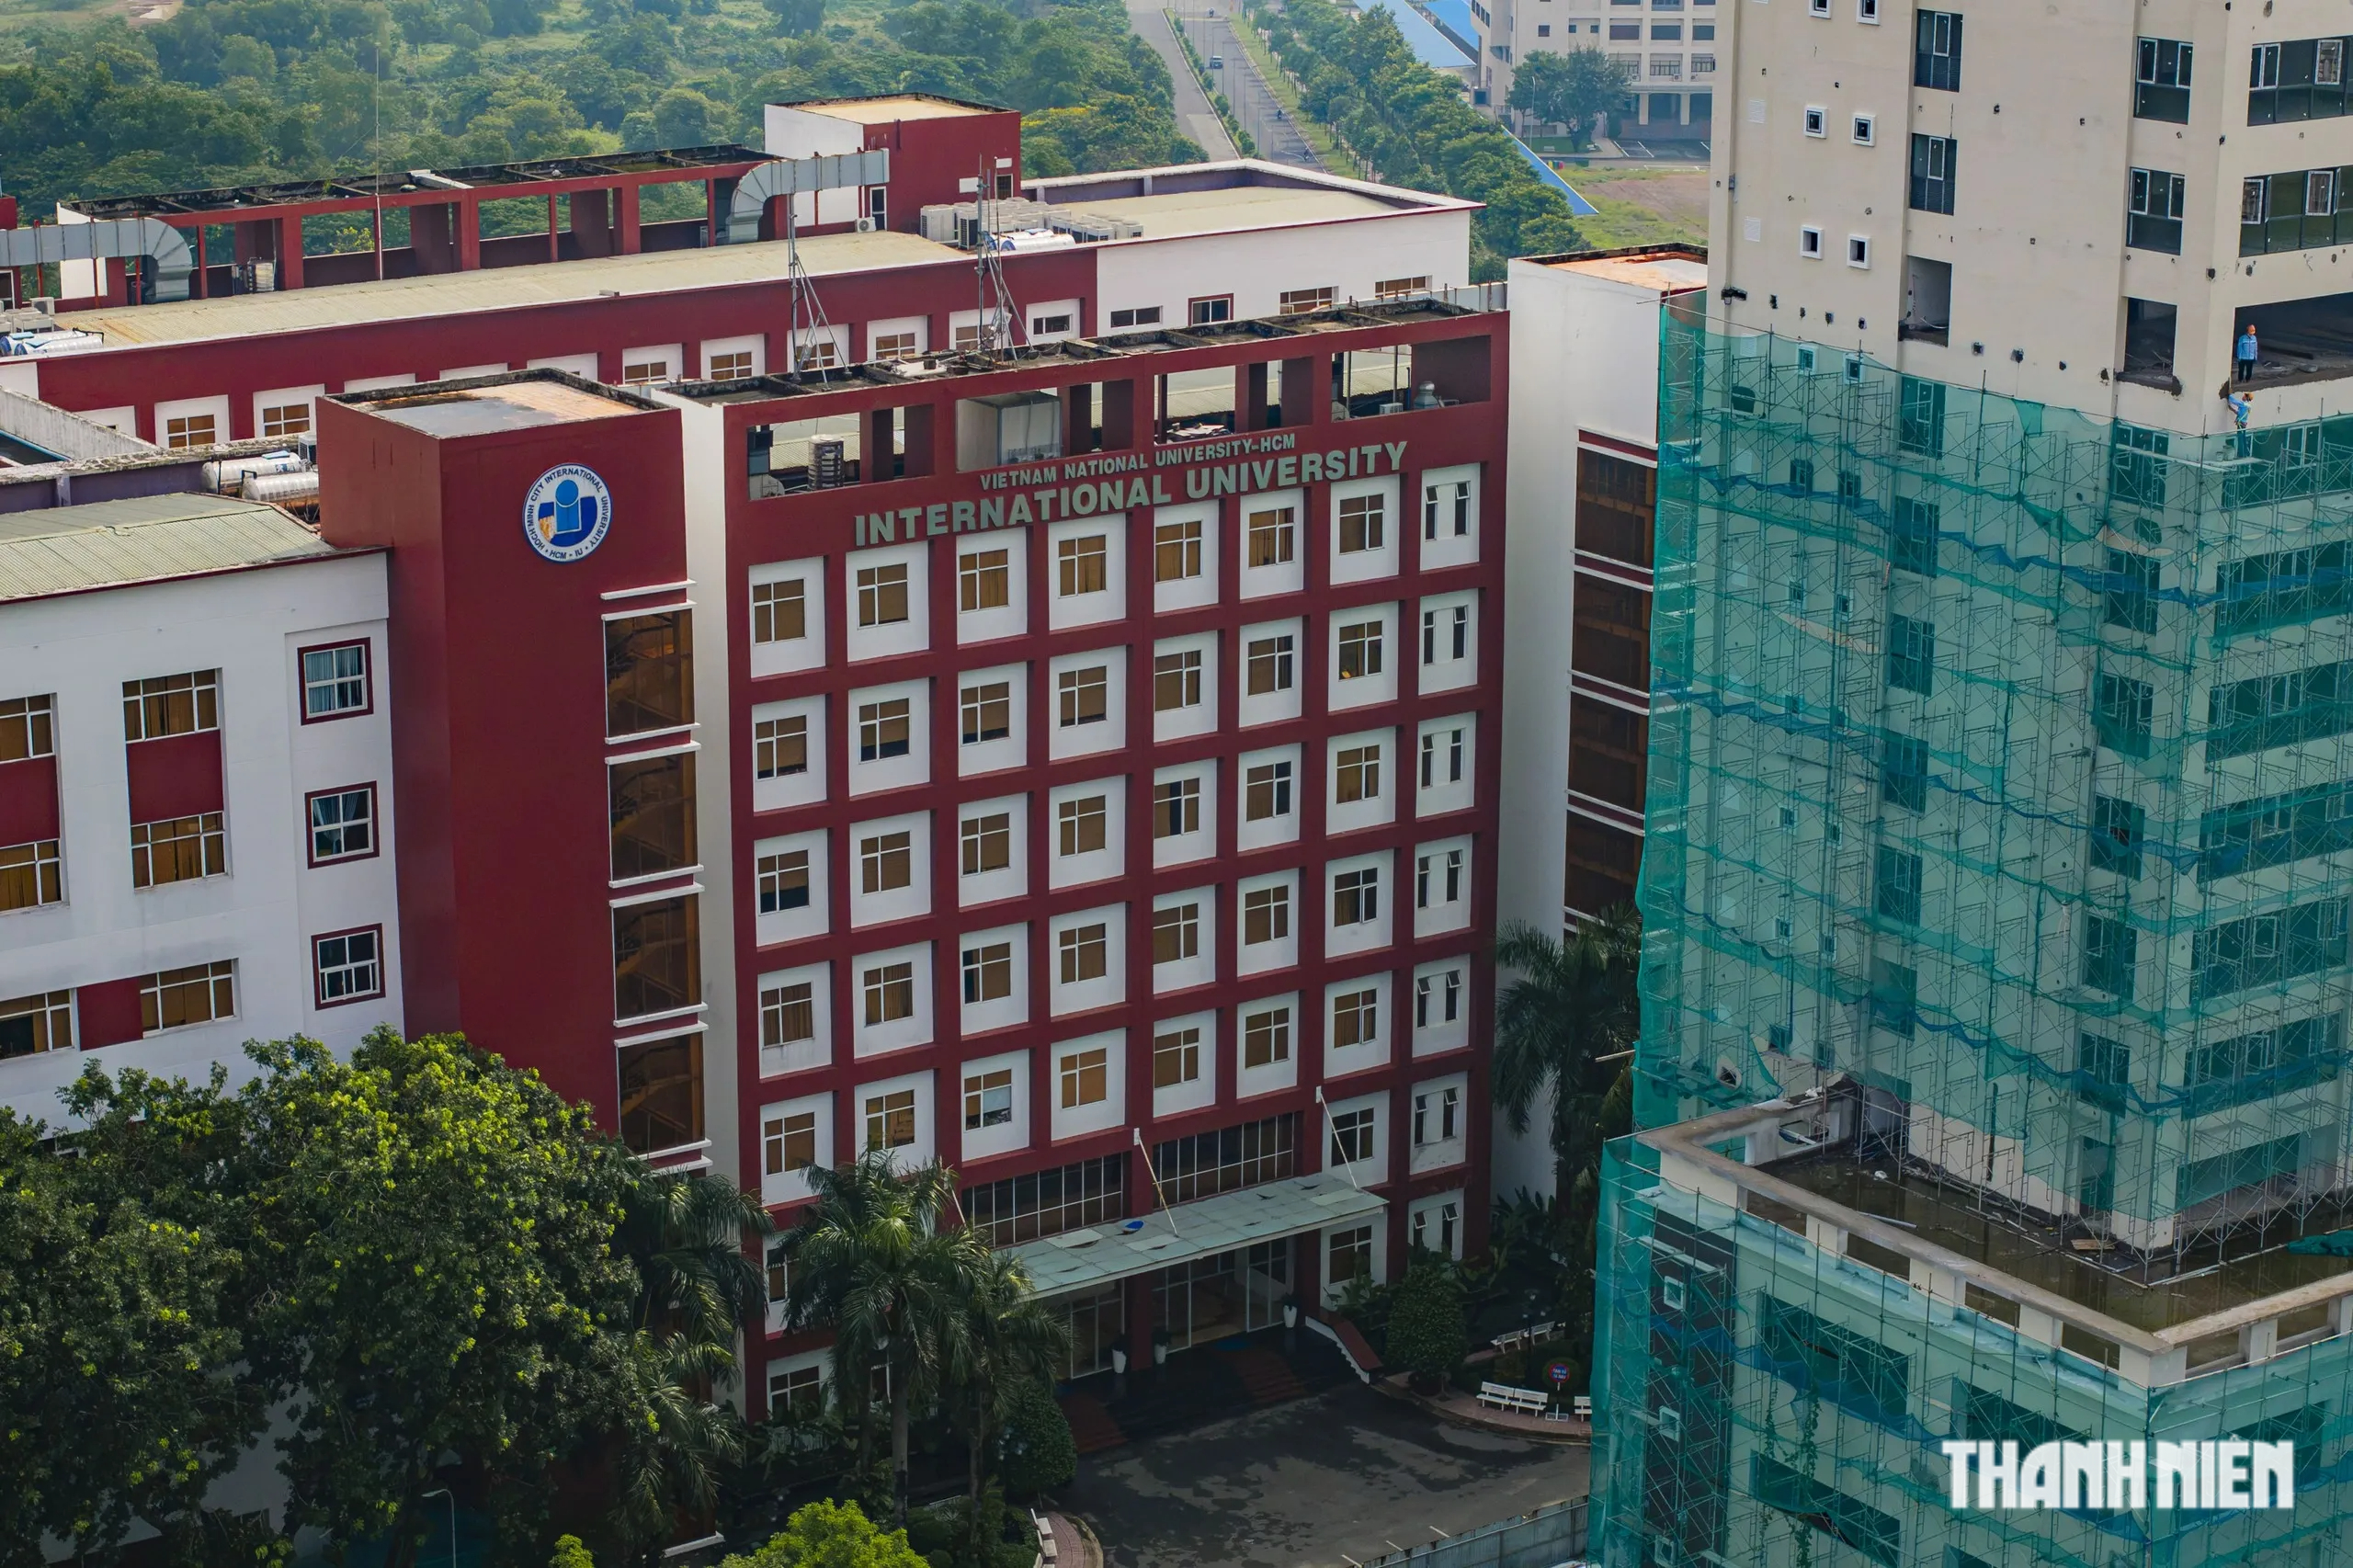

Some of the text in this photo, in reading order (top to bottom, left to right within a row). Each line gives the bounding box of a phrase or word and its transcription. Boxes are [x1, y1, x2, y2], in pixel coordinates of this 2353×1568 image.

[854, 441, 1408, 546] INTERNATIONAL UNIVERSITY
[980, 434, 1295, 491] VIETNAM NATIONAL UNIVERSITY-HCM
[530, 483, 544, 502] CITY
[544, 468, 603, 494] INTERNATIONAL
[590, 496, 609, 548] UNIVERSITY
[549, 548, 584, 560] HCM IU
